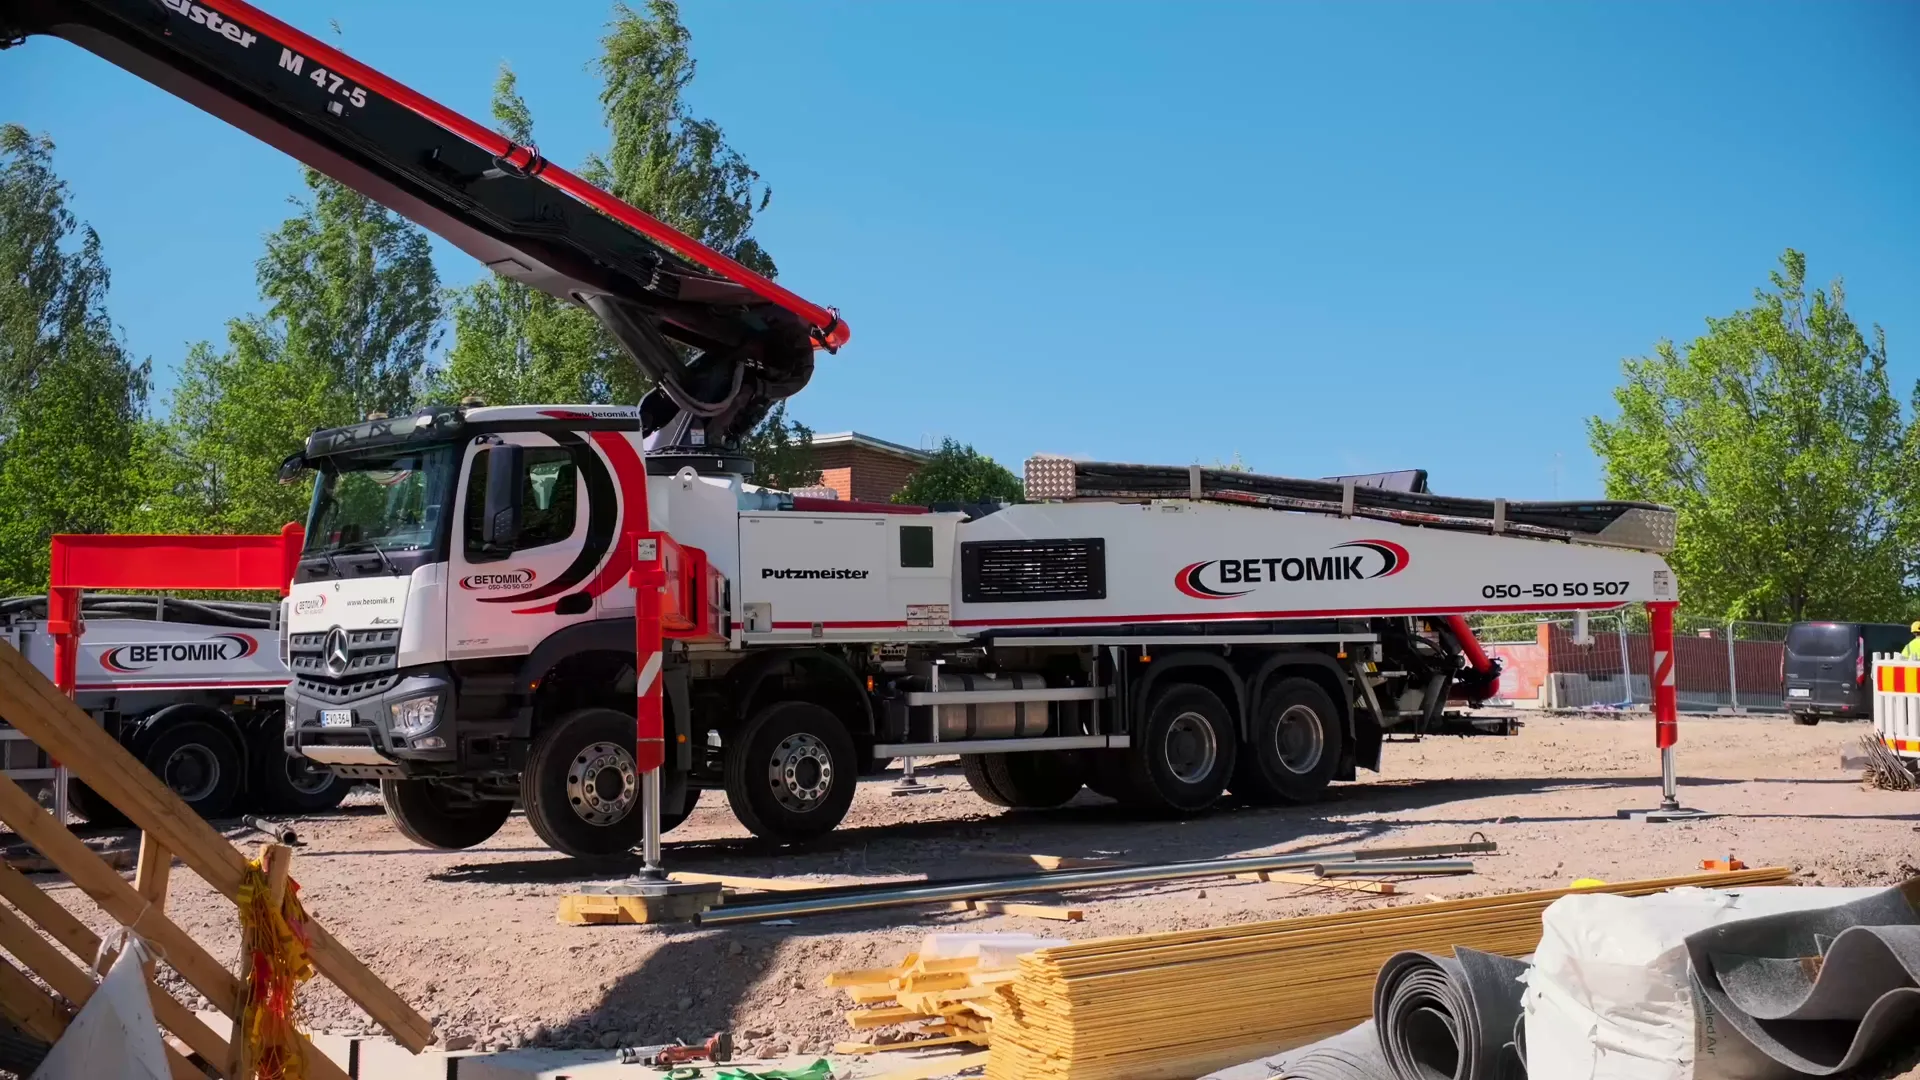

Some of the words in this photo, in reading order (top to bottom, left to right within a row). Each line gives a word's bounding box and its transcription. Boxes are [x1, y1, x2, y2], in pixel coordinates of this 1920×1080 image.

[278, 48, 304, 76] M
[310, 68, 367, 108] 47-5
[761, 568, 869, 579] Putzmeister
[1219, 556, 1364, 584] BETOMIK
[474, 574, 522, 585] BETOMIK
[1482, 583, 1558, 599] 050-50
[1563, 582, 1588, 597] 50
[1593, 581, 1630, 596] 507
[346, 597, 395, 606] www.betomik.fi
[130, 644, 228, 662] BETOMIK
[1702, 992, 1716, 1034] ealed
[1707, 1036, 1716, 1056] Air
